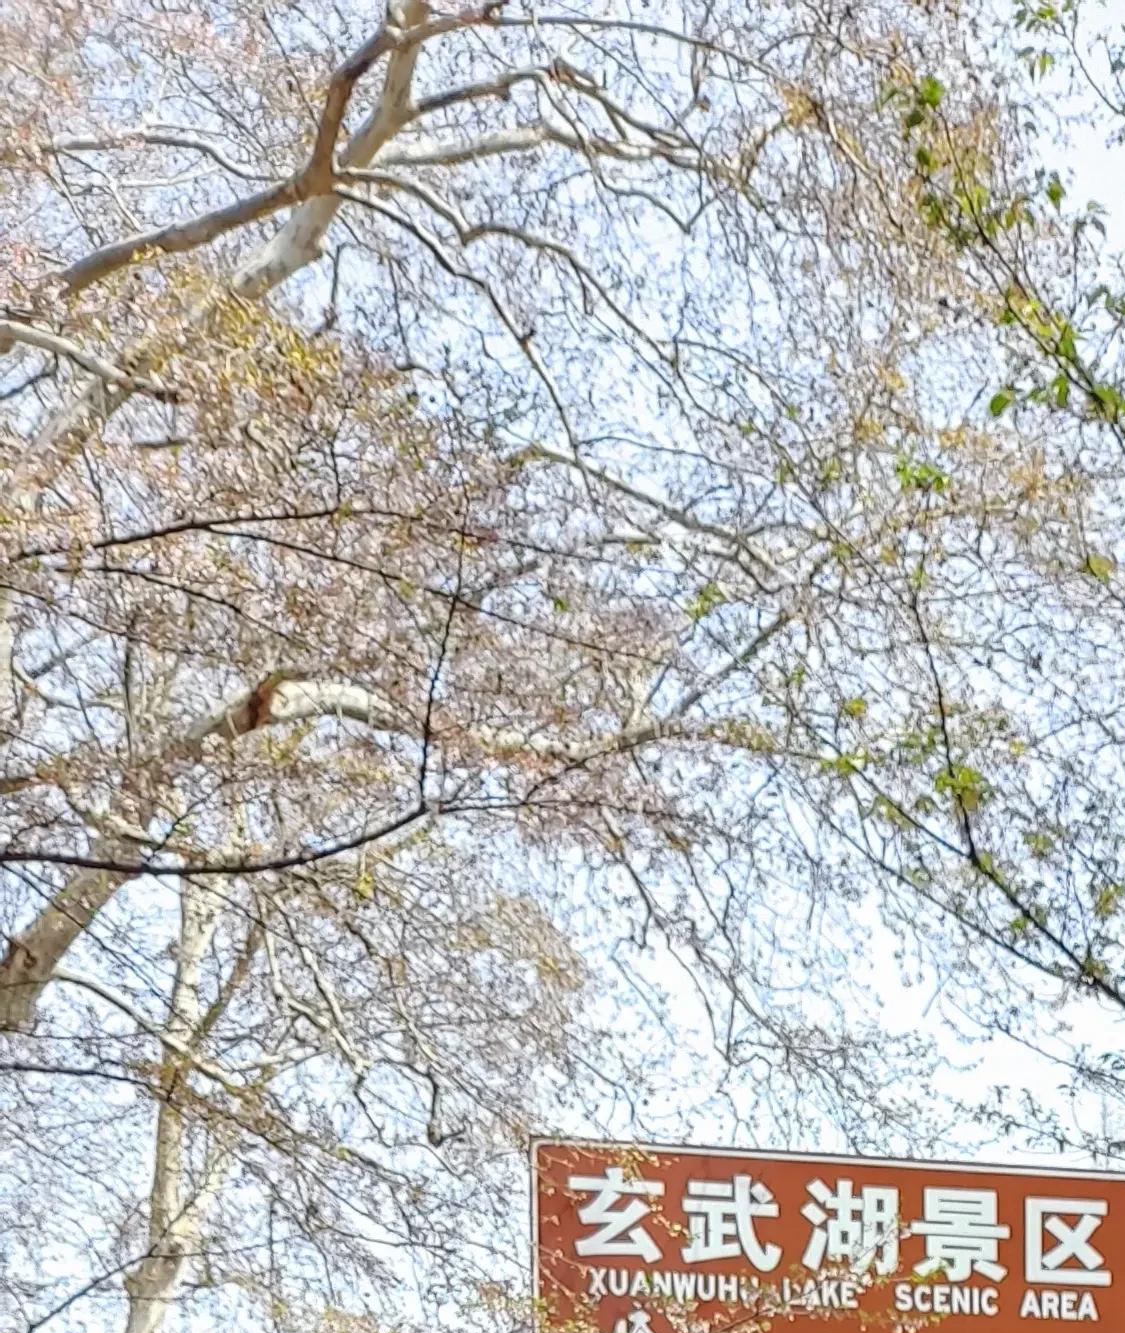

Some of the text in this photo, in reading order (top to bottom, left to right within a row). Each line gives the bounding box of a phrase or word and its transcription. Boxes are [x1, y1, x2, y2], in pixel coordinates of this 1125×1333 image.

[568, 1167, 1111, 1285] 玄武湖景区
[781, 1276, 858, 1309] LAKE
[894, 1282, 1000, 1317] SCENIC
[1019, 1288, 1099, 1322] AREA
